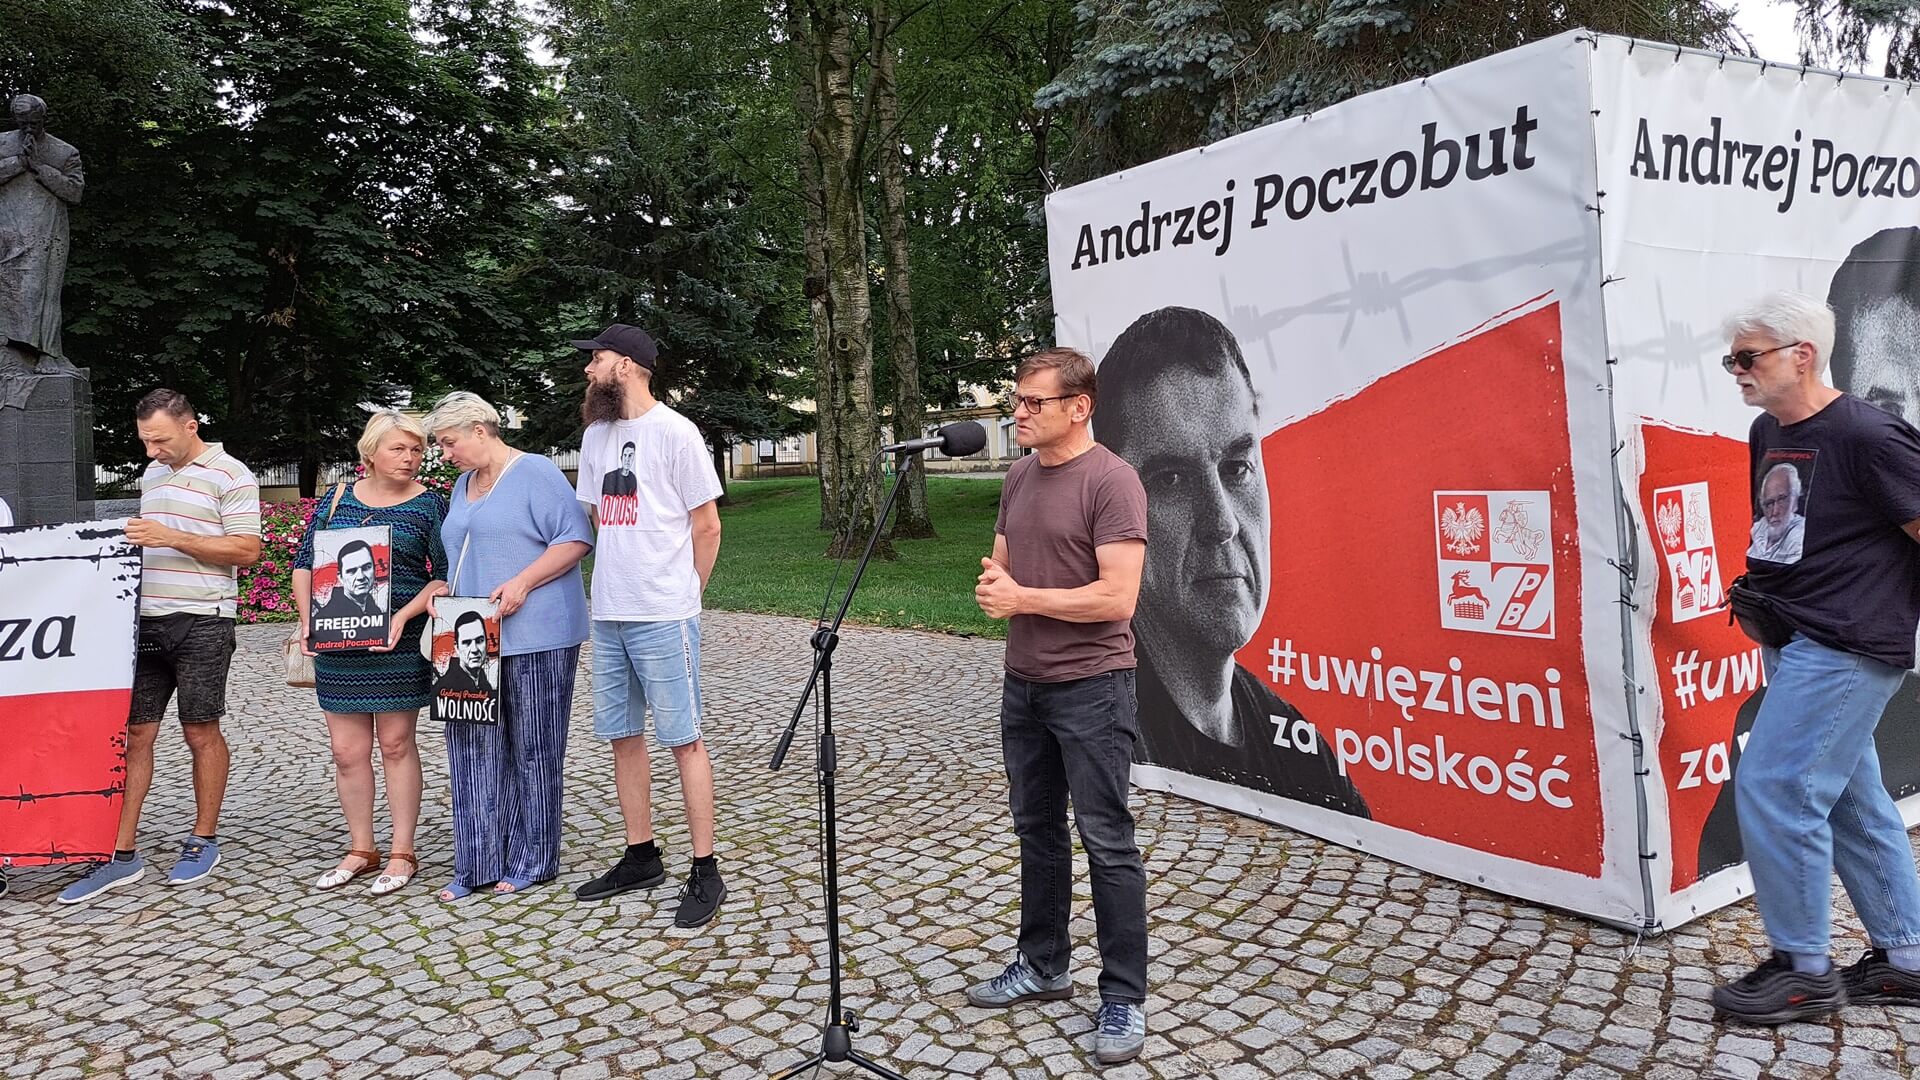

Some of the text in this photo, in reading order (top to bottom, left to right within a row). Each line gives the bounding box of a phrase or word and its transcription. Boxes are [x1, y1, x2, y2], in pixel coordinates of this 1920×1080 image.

[1630, 117, 1920, 213] Andrzej Poczo
[1071, 104, 1538, 270] Andrzej Poczobut
[601, 488, 638, 526] OLNOŚĆ
[314, 638, 383, 649] Andrzej Poczobut
[315, 615, 384, 631] FREEDOM
[341, 629, 357, 639] TO
[1267, 637, 1565, 729] #uwięzieni
[436, 695, 496, 722] WOLNOŚĆ
[1269, 713, 1574, 809] za polskość
[1676, 741, 1731, 790] za
